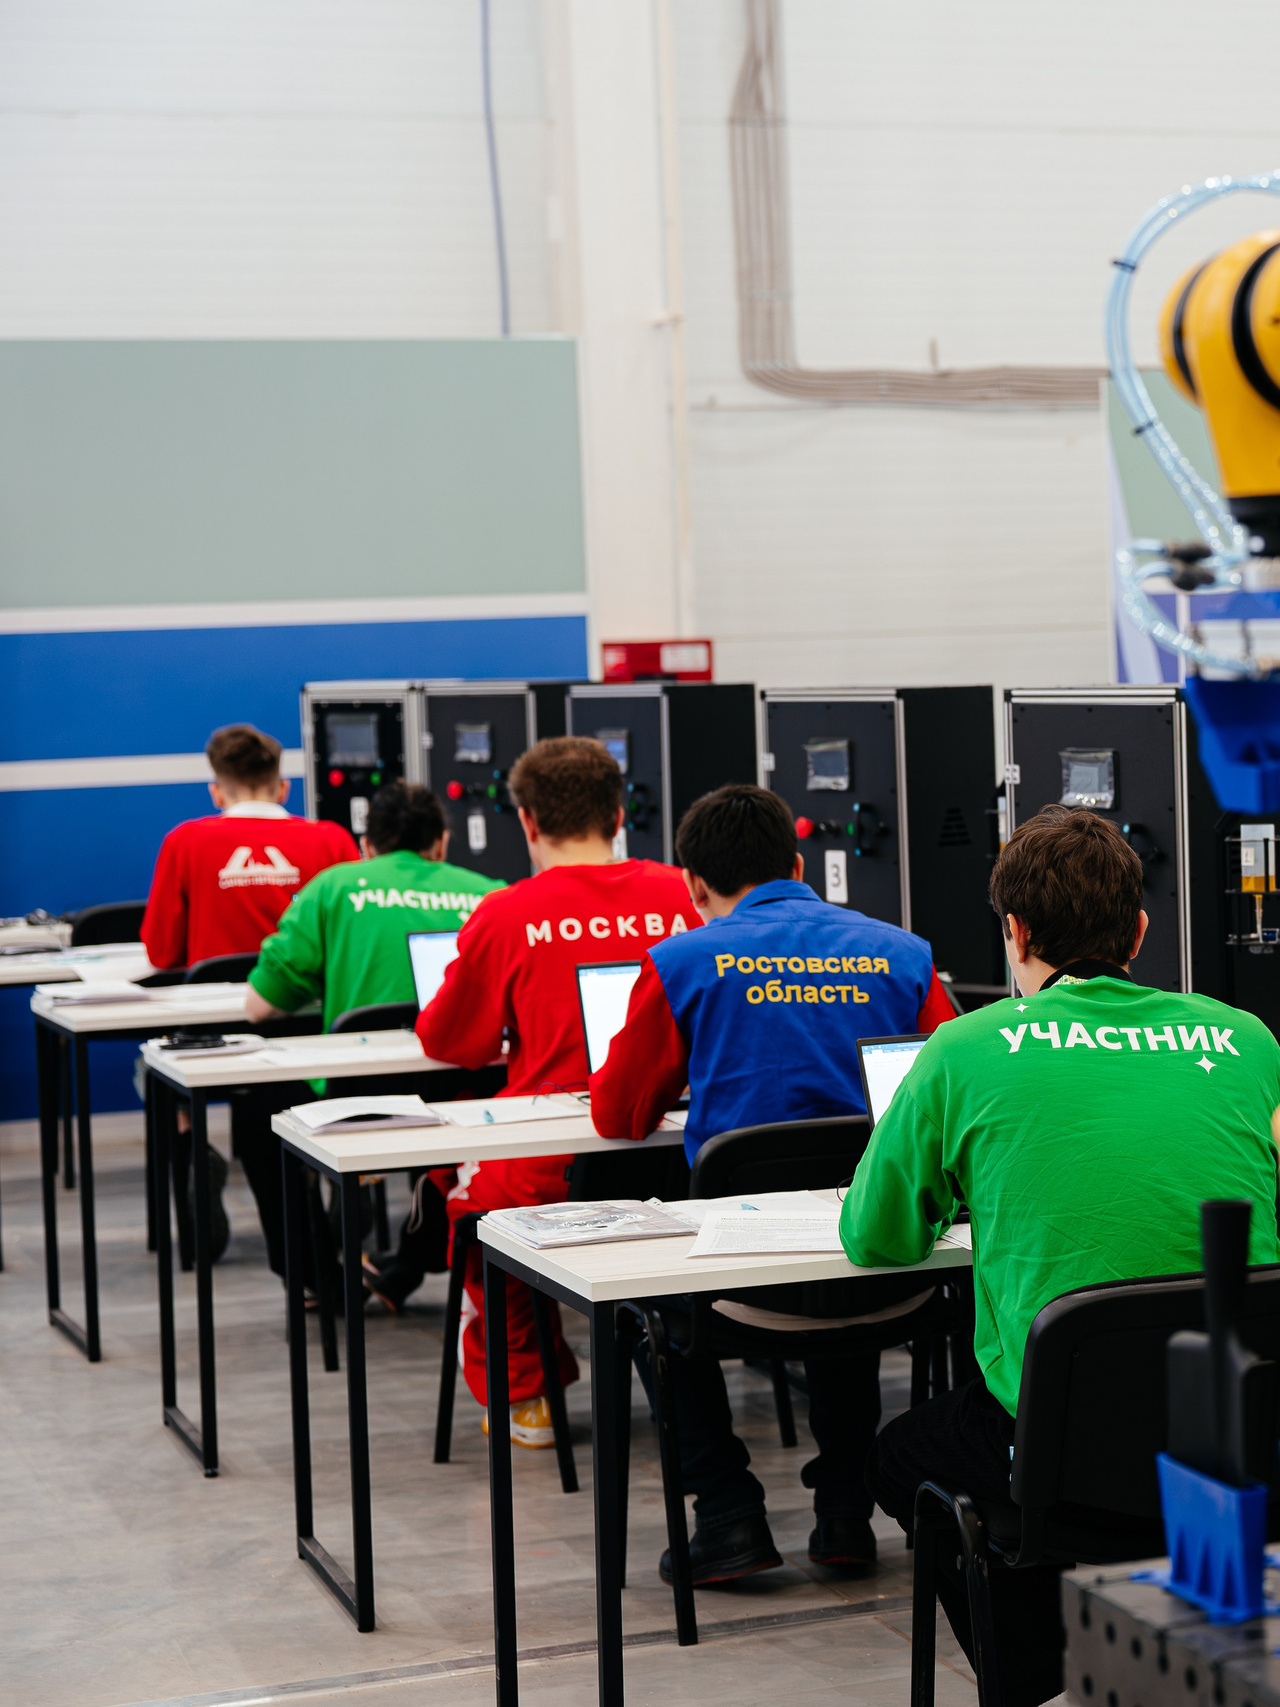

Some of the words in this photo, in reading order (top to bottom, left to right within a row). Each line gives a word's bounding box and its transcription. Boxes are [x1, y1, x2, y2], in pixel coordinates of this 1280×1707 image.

[831, 863, 842, 888] 3
[525, 913, 689, 947] МОСКВА
[715, 953, 890, 977] Ростовская
[746, 979, 870, 1004] область
[998, 1021, 1241, 1057] УЧАСТНИК
